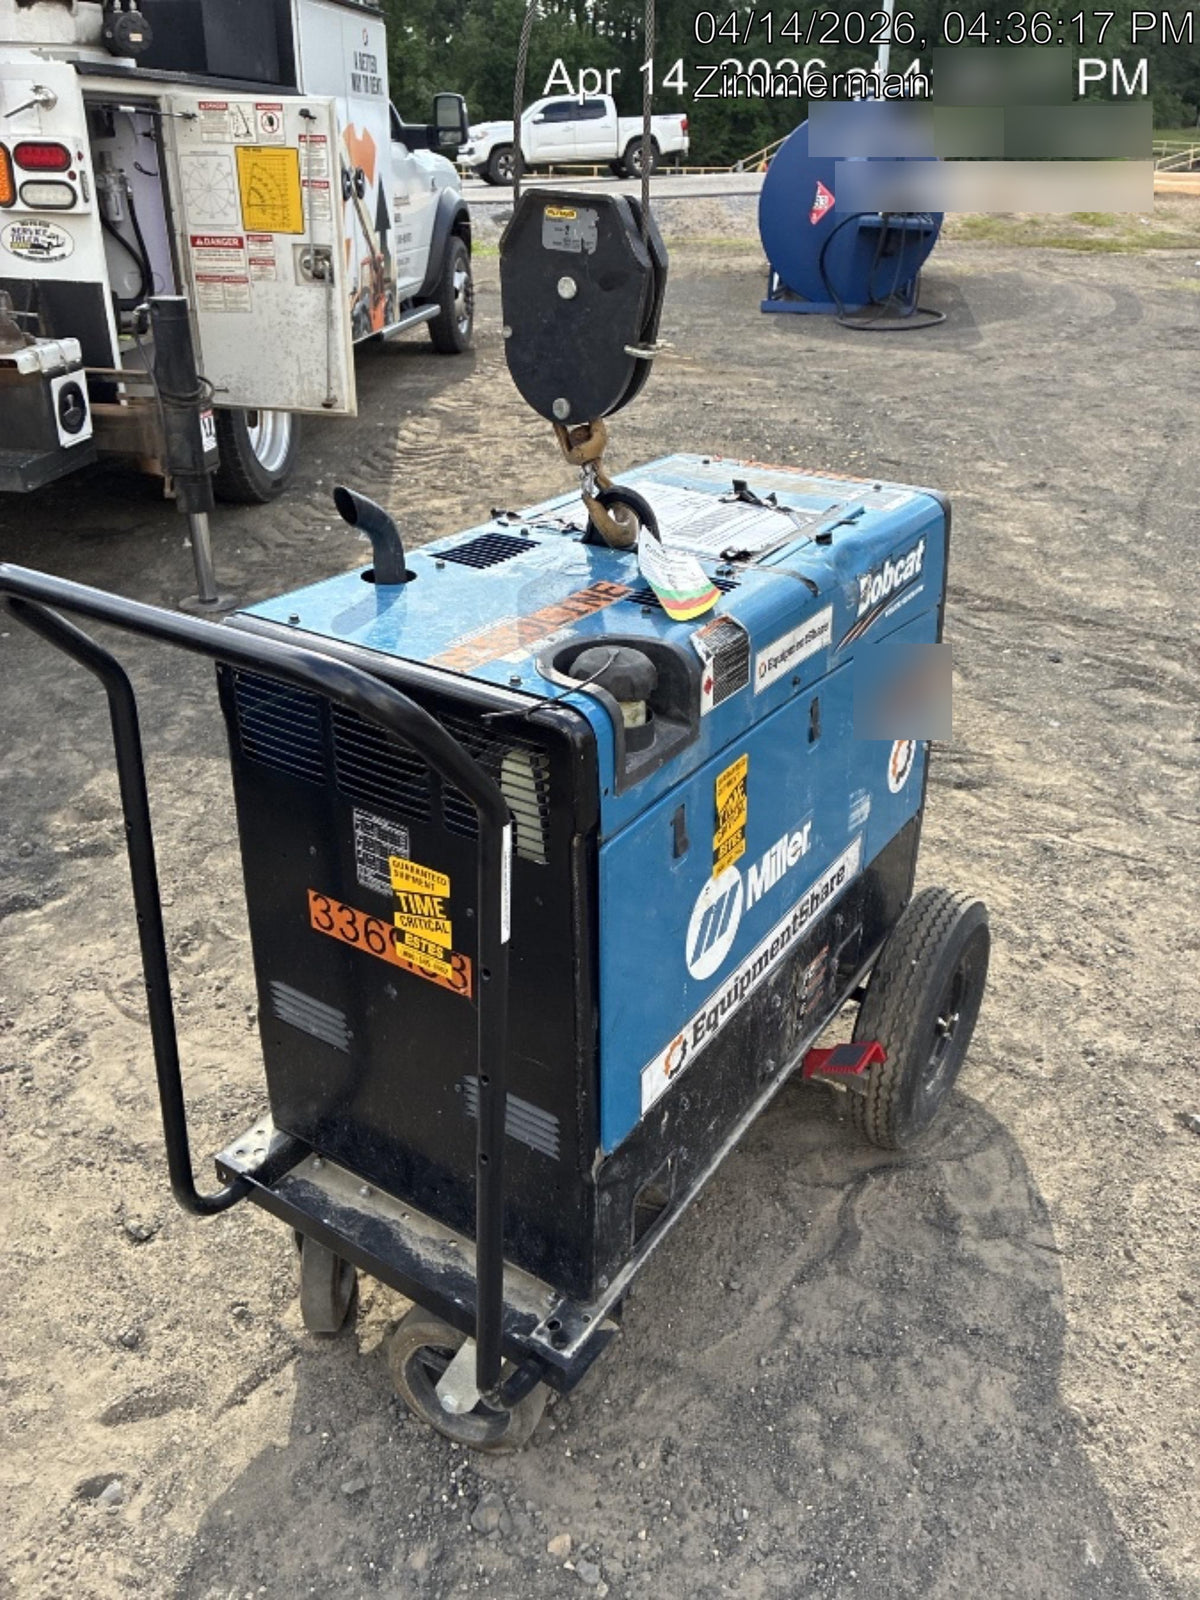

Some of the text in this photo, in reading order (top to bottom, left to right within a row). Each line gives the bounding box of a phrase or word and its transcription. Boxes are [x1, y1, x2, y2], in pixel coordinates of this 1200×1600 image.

[203, 237, 240, 247] DANGER
[857, 536, 926, 617] Bobcat
[747, 820, 812, 911] Miller
[396, 891, 447, 919] TIME
[399, 915, 450, 934] CRITICAL
[405, 932, 444, 959] ESTES
[691, 865, 846, 1050] EquipmentShare
